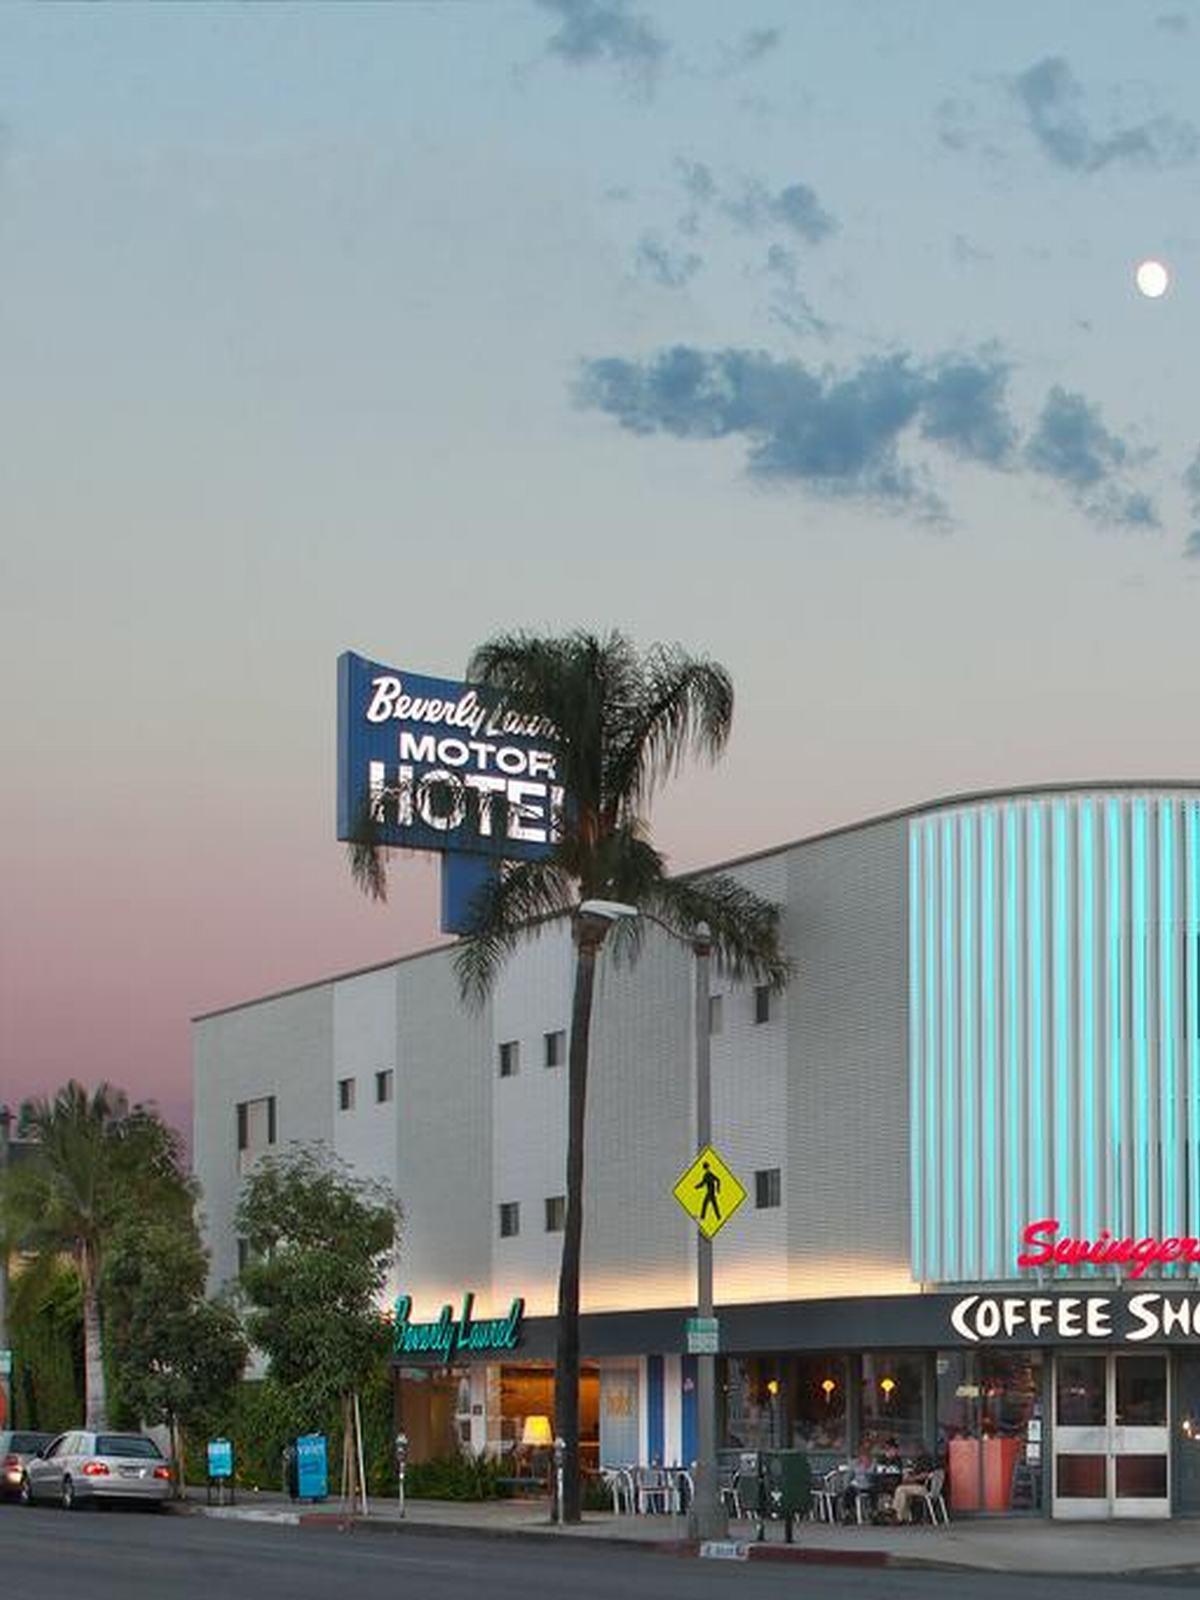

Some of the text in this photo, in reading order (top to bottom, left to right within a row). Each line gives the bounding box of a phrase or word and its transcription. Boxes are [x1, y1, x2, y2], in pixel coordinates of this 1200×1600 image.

[366, 675, 563, 741] Beverly Laur
[399, 731, 556, 779] MOTOR
[393, 1293, 521, 1363] Beverly Laurel
[951, 1295, 1113, 1341] COFFEE
